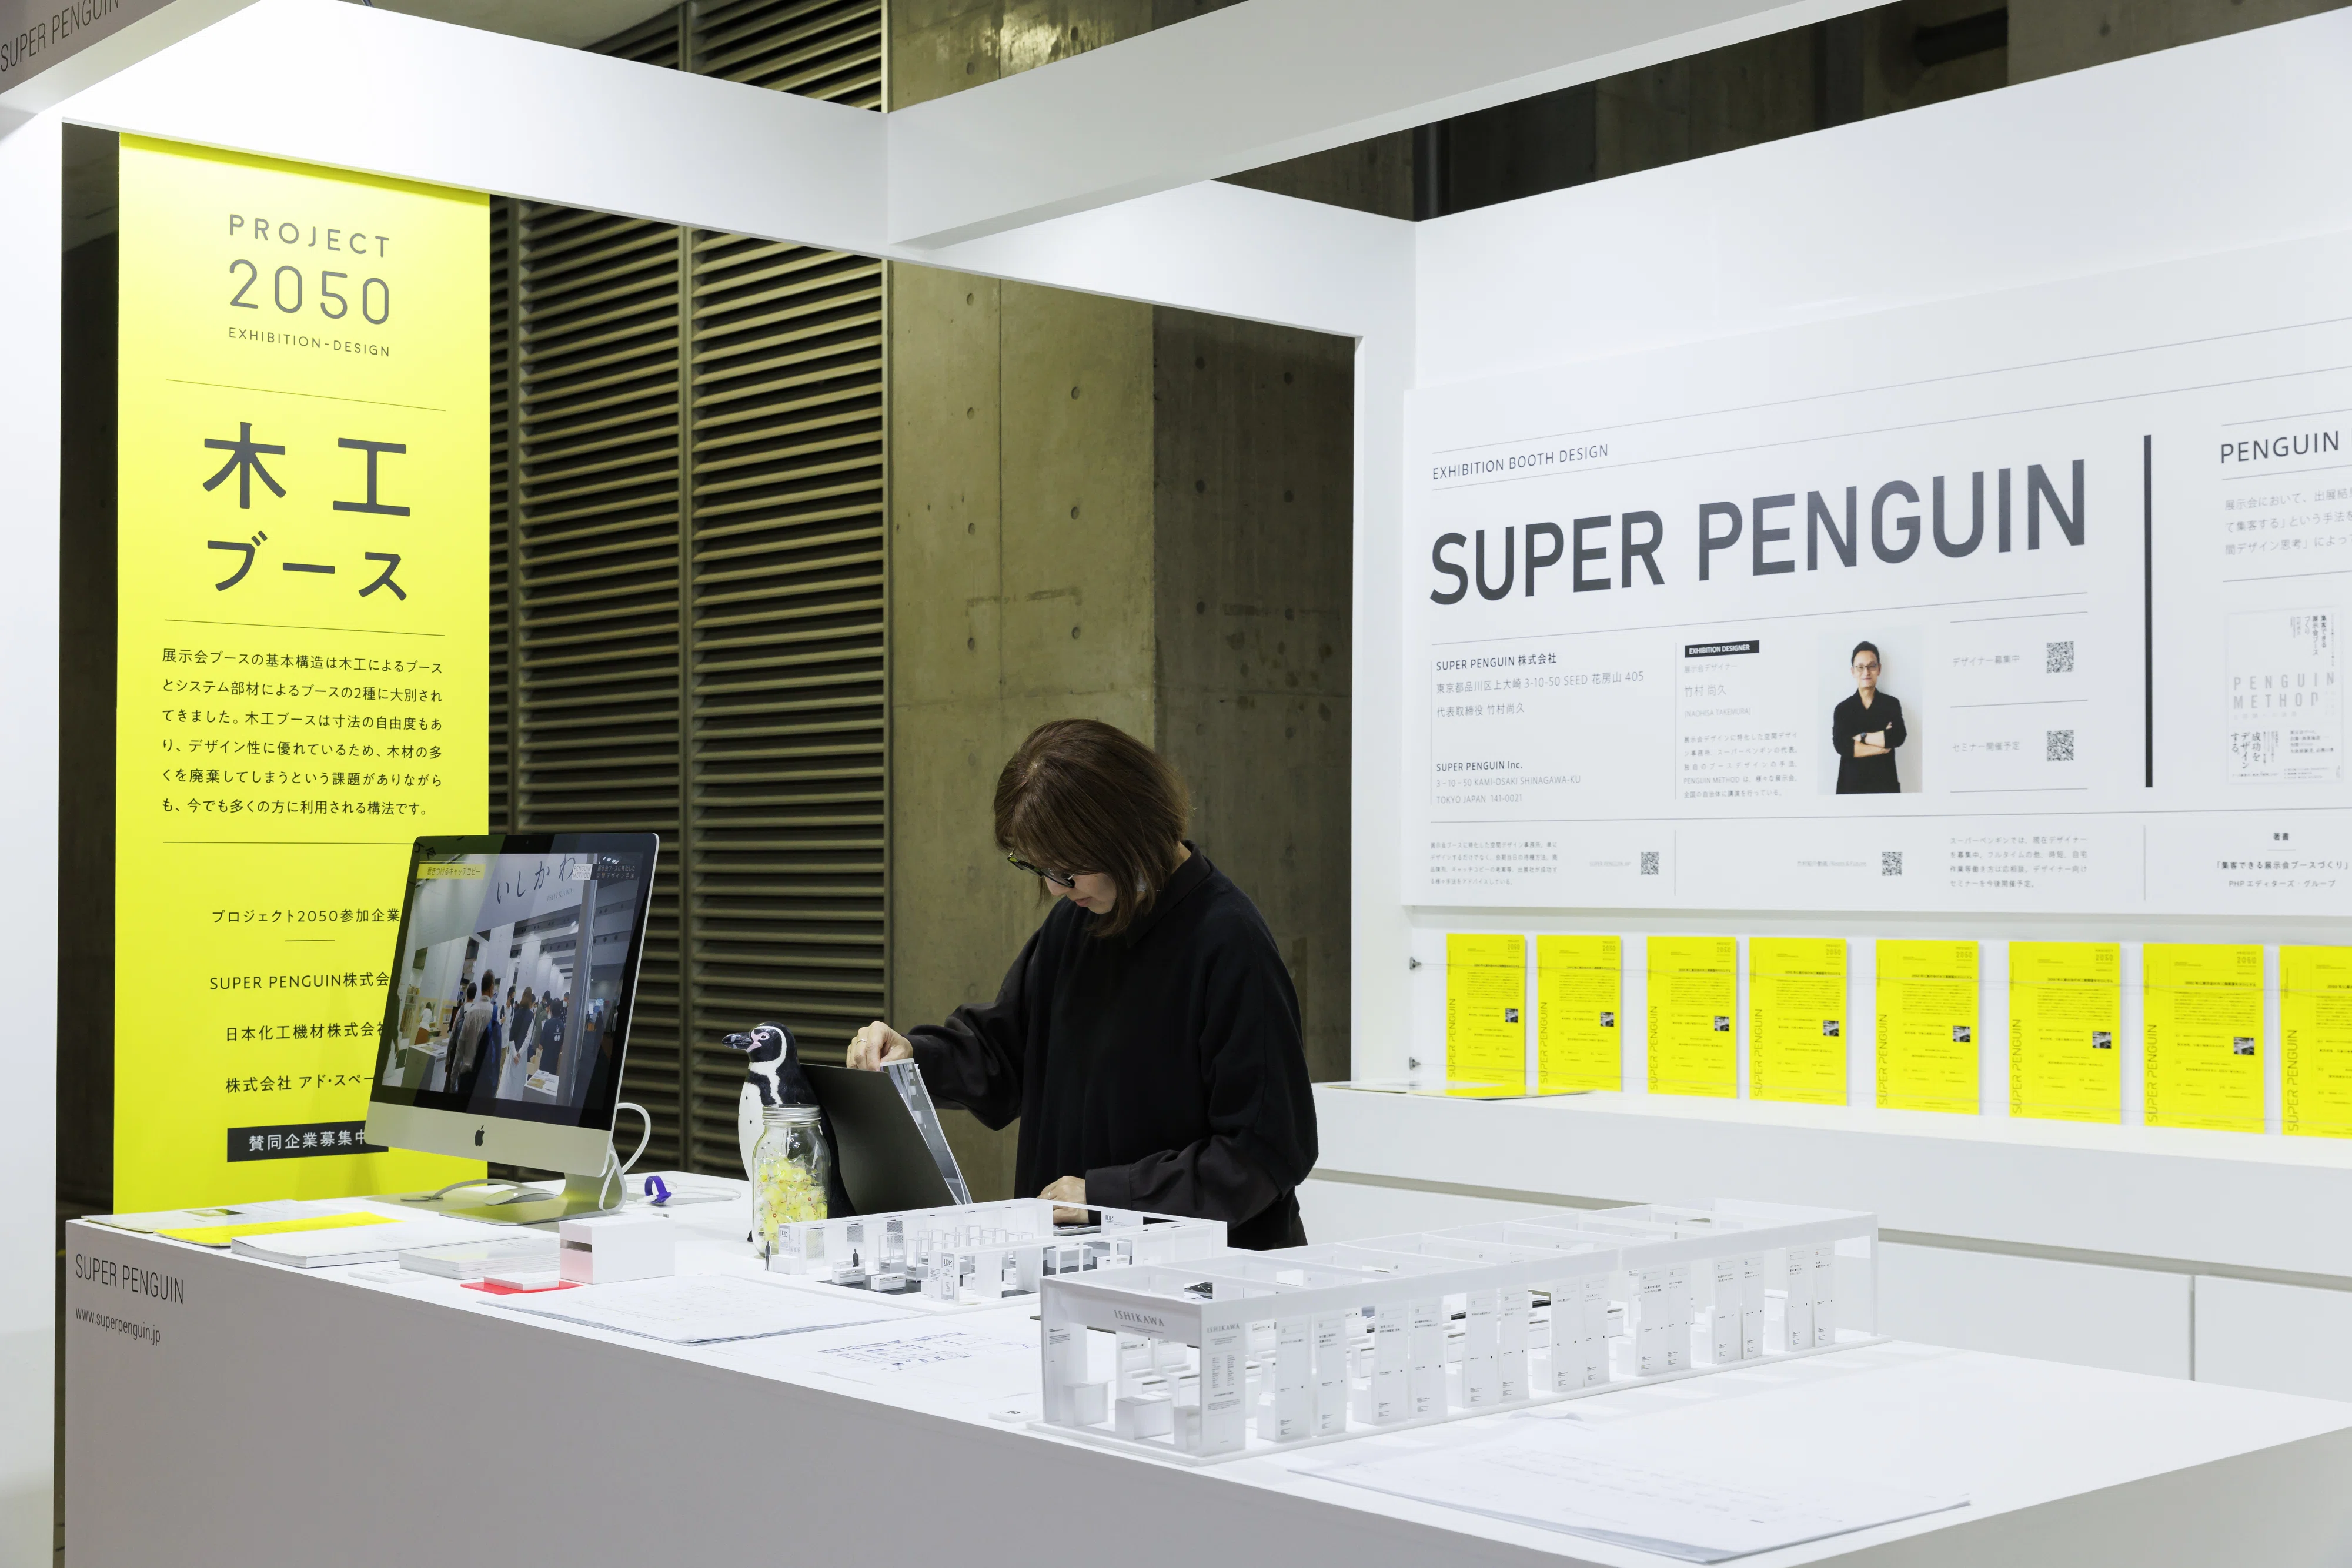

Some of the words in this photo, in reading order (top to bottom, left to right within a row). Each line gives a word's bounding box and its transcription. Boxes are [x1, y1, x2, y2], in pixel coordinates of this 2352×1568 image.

[1, 23, 46, 72] SUPER
[229, 214, 390, 258] PROJECT
[229, 259, 390, 325] 2050
[229, 327, 390, 357] EXHIBITION-DESIGN
[1433, 459, 1504, 480] EXHIBITION
[1509, 451, 1554, 470] BOOTH
[1559, 444, 1609, 463] DESIGN
[2221, 430, 2339, 464] PENGUIN
[203, 422, 411, 517] 木工
[2225, 487, 2352, 511] 展示会において、出展結
[1430, 510, 1665, 606] SUPER
[1699, 459, 2085, 581] PENGUIN
[207, 530, 407, 601] ブース
[162, 648, 443, 674] 展示会ブースの基本構造は木工によるブース
[1436, 659, 1467, 671] SUPER
[1470, 656, 1515, 669] PENGUIN
[1518, 652, 1557, 667] 株式会社
[1689, 646, 1721, 655] EXHIBITION
[1722, 644, 1750, 653] DESIGNER
[162, 677, 443, 703] とシステム部材によるブースの2種に大別され
[1436, 678, 1522, 694] 東京都品川区上大崎
[1524, 677, 1561, 689] 3-10-50
[1563, 676, 1588, 686] SEED
[1591, 671, 1622, 685] 花房山
[1625, 671, 1645, 682] 405
[2234, 672, 2334, 691] PENGUIN
[162, 708, 443, 731] てきました。木工ブースは寸法の自由度もあ
[1436, 704, 1484, 718] 代表取締役
[1486, 703, 1525, 716] 竹村尚久
[162, 738, 443, 760] り、デザイン性に優れているため、木材の多
[162, 768, 443, 787] くを廃棄してしまうという課題がありながら
[1436, 763, 1464, 772] SUPER
[1466, 761, 1505, 771] PENGUIN
[1508, 761, 1523, 770] Inc.
[1474, 777, 1518, 787] KAMI-OSAKI
[1520, 775, 1581, 785] SHINAGAWA-KU
[162, 798, 427, 816] も、今でも多くの方に利用される構法です。
[1436, 795, 1461, 804] TOKYO
[1463, 795, 1486, 804] JAPAN
[1491, 794, 1523, 803] 141-0021
[497, 854, 576, 904] いしかわ
[212, 908, 400, 924] プロジェクト2050参加企業
[210, 977, 262, 990] SUPER
[1448, 998, 1456, 1042] PENGUIN
[1540, 1002, 1548, 1045] PENGUIN
[1649, 1006, 1658, 1051] PENGUIN
[1754, 1009, 1763, 1055] PENGUIN
[1879, 1014, 1888, 1064] PENGUIN
[2012, 1019, 2022, 1071] PENGUIN
[2147, 1024, 2157, 1078] PENGUIN
[2287, 1029, 2298, 1086] PENGUIN
[225, 1075, 292, 1094] 株式会社
[76, 1253, 117, 1288] SUPER
[122, 1265, 183, 1305] PENGUIN
[75, 1307, 161, 1346] www.superpenguin.jp
[1113, 1309, 1165, 1327] ISHIKAWA
